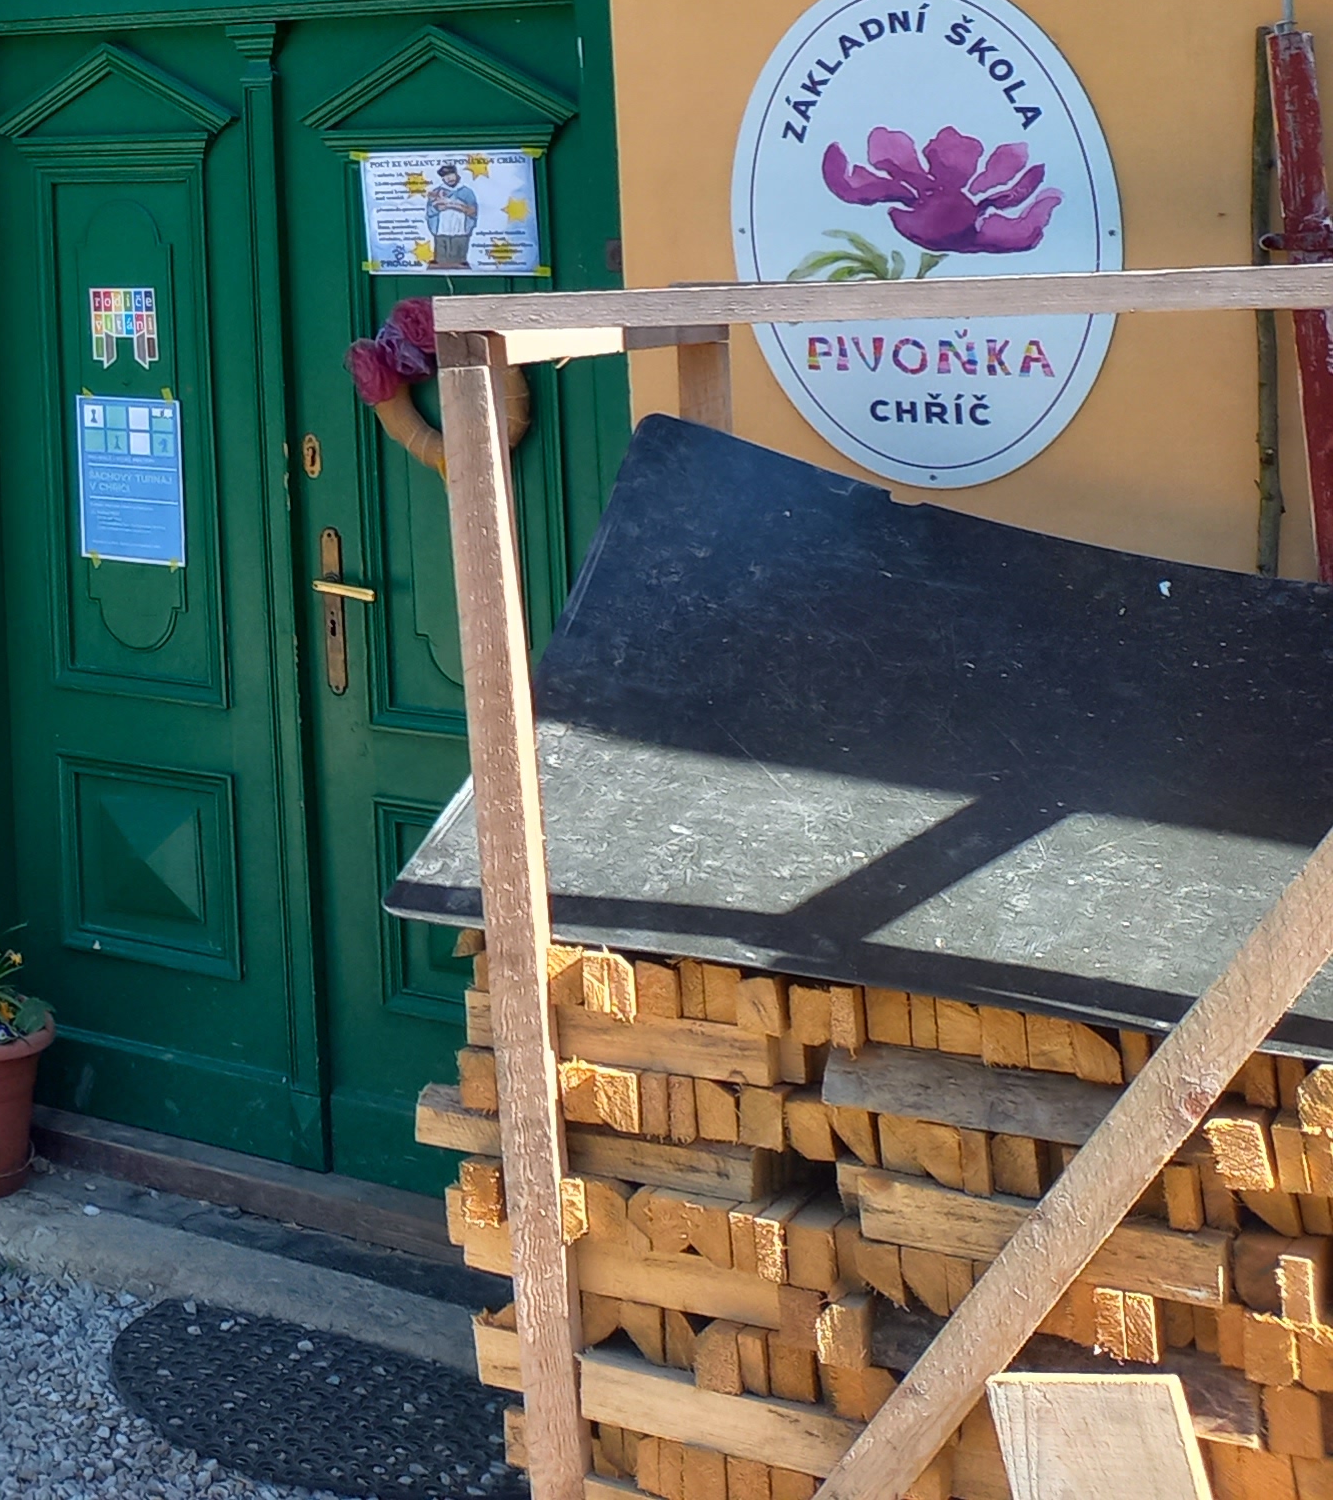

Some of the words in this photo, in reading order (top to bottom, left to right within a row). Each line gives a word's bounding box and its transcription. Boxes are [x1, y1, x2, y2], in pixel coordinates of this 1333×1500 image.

[781, 3, 931, 144] ZÁKLADNÍ
[944, 14, 1043, 131] ŠKOLA
[94, 292, 152, 307] rodiče
[807, 328, 1055, 378] PIVOŇKA
[870, 392, 992, 426] CHŘÍČ
